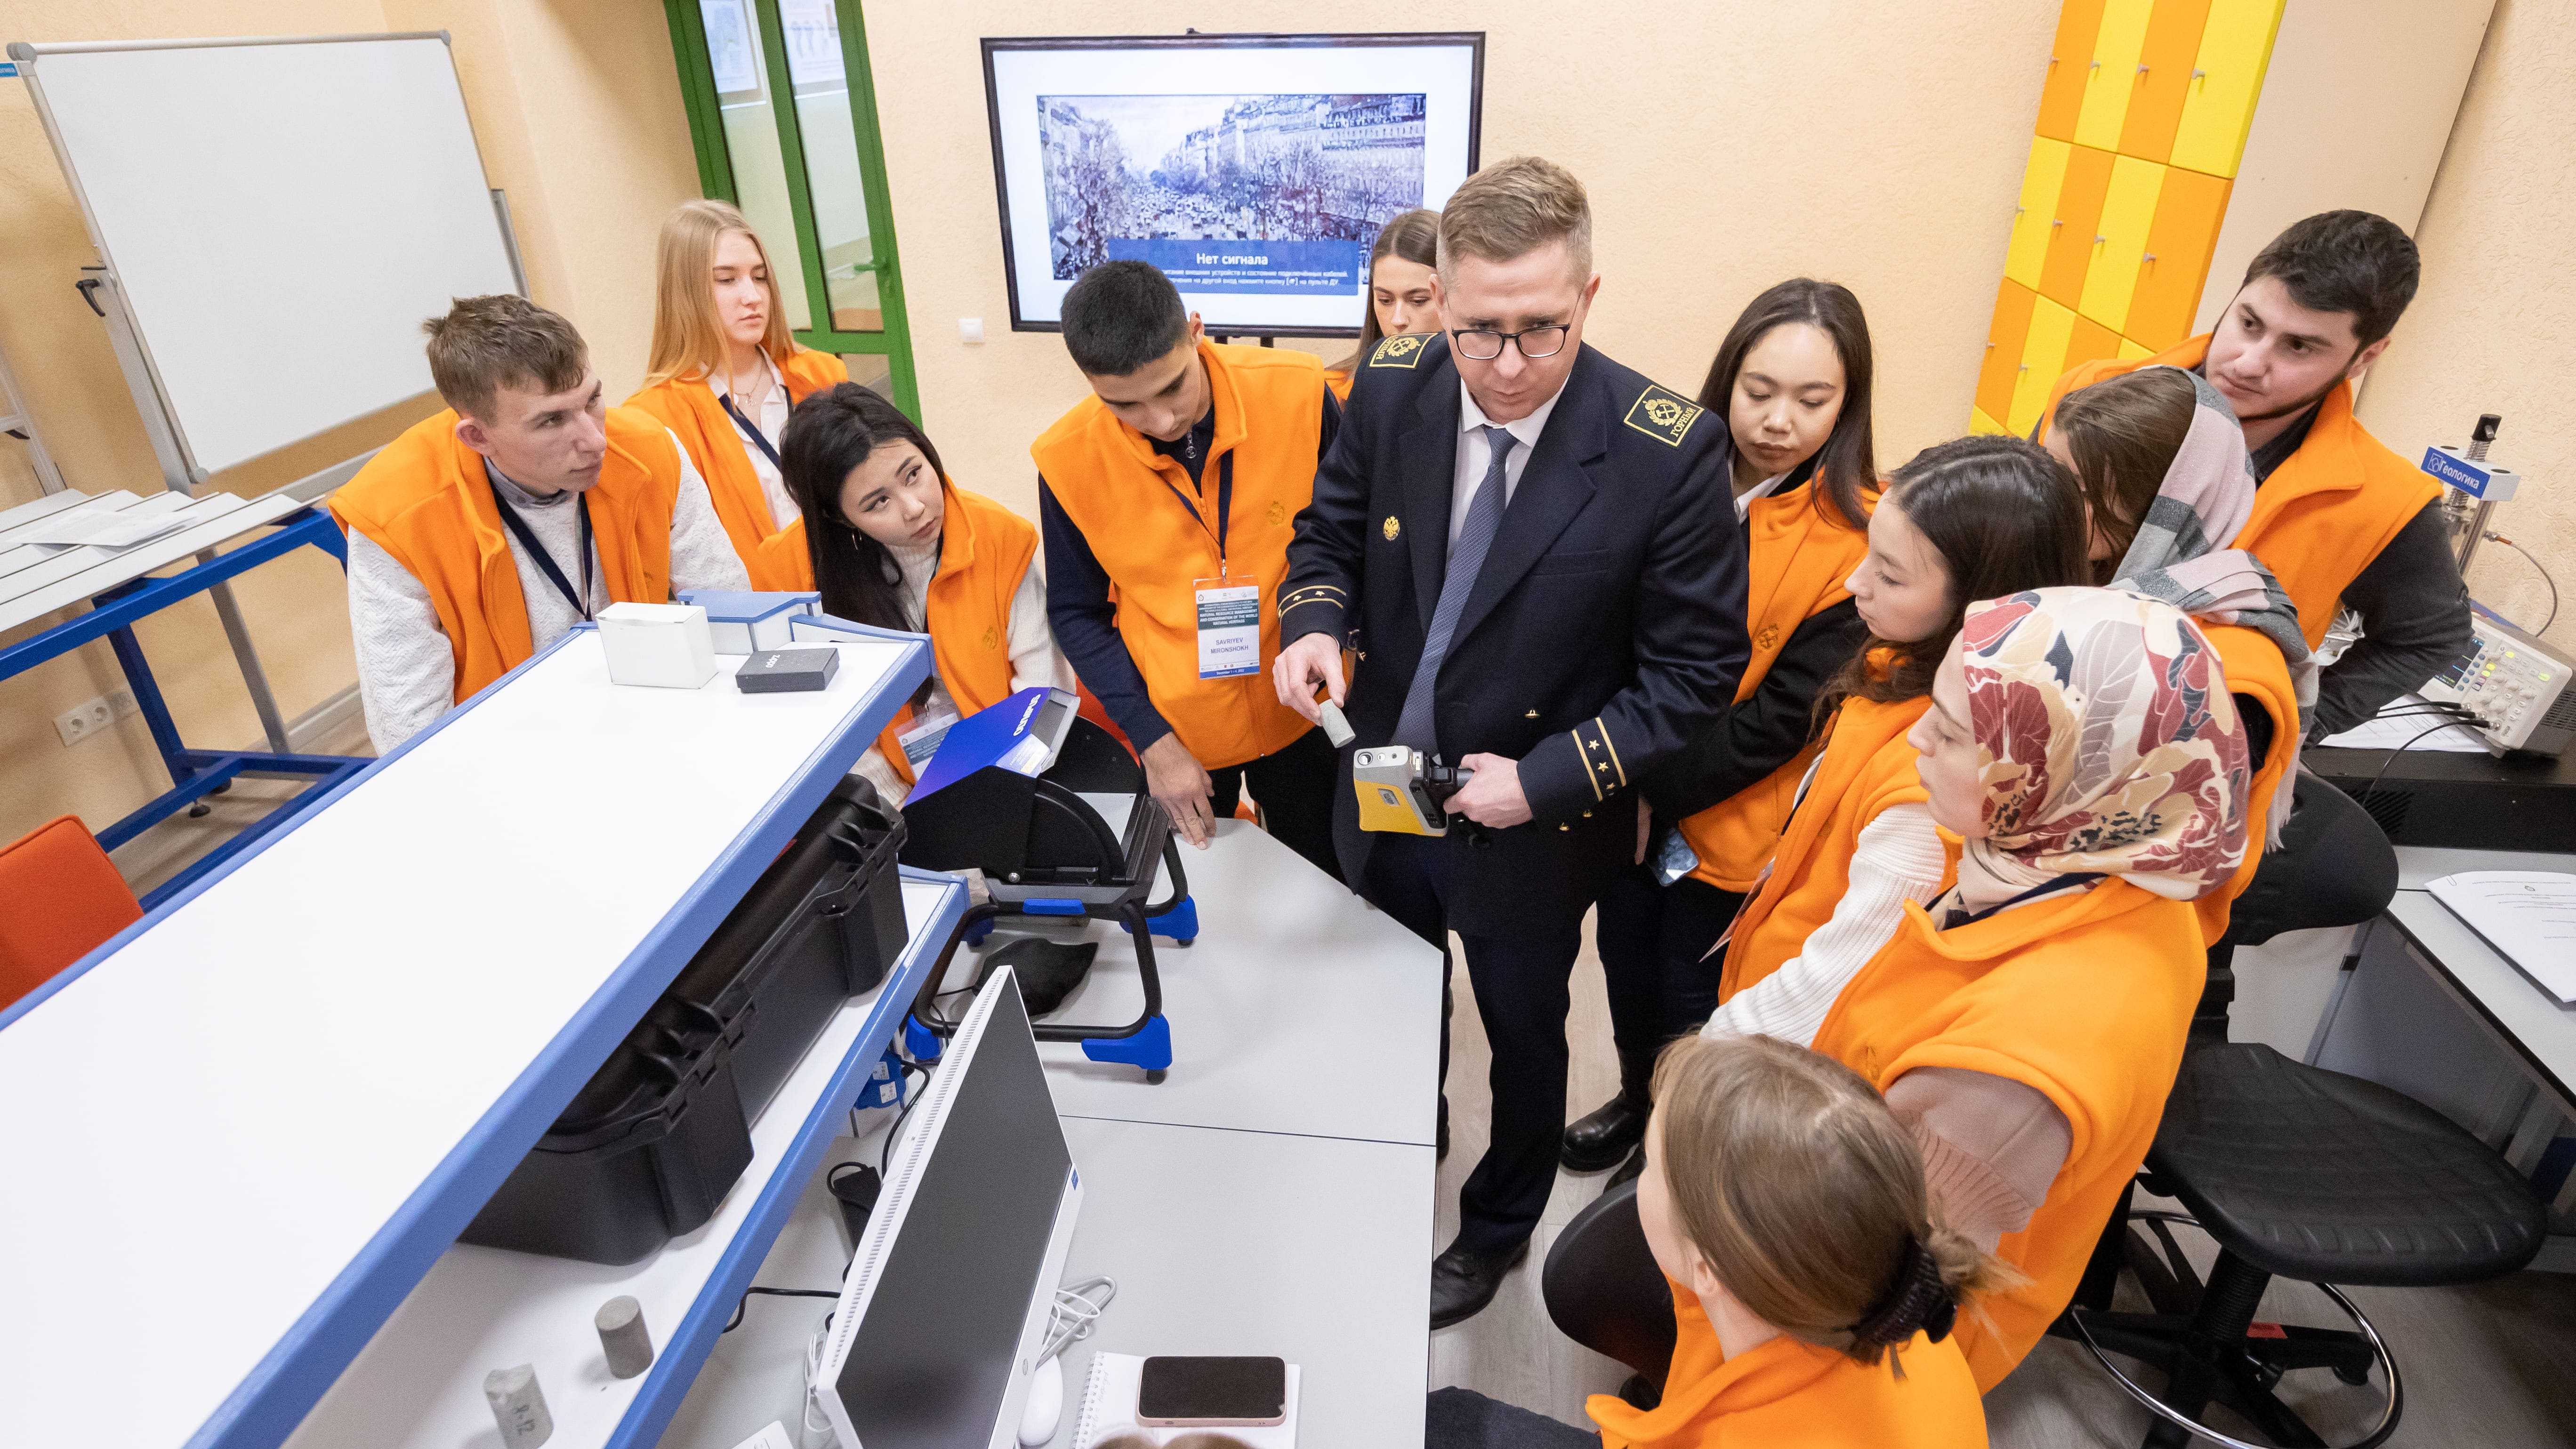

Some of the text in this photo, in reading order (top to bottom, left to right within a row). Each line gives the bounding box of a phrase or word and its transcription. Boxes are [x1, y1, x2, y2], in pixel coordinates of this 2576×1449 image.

[1196, 252, 1268, 265] Нет сигнала
[1670, 407, 1696, 437] ГОРНЫЙ
[2439, 459, 2480, 490] Геологика
[1211, 645, 1249, 654] MIRONSHOKH
[1216, 637, 1243, 645] SAVRIYEV
[1013, 693, 1041, 737] OLYMPUS
